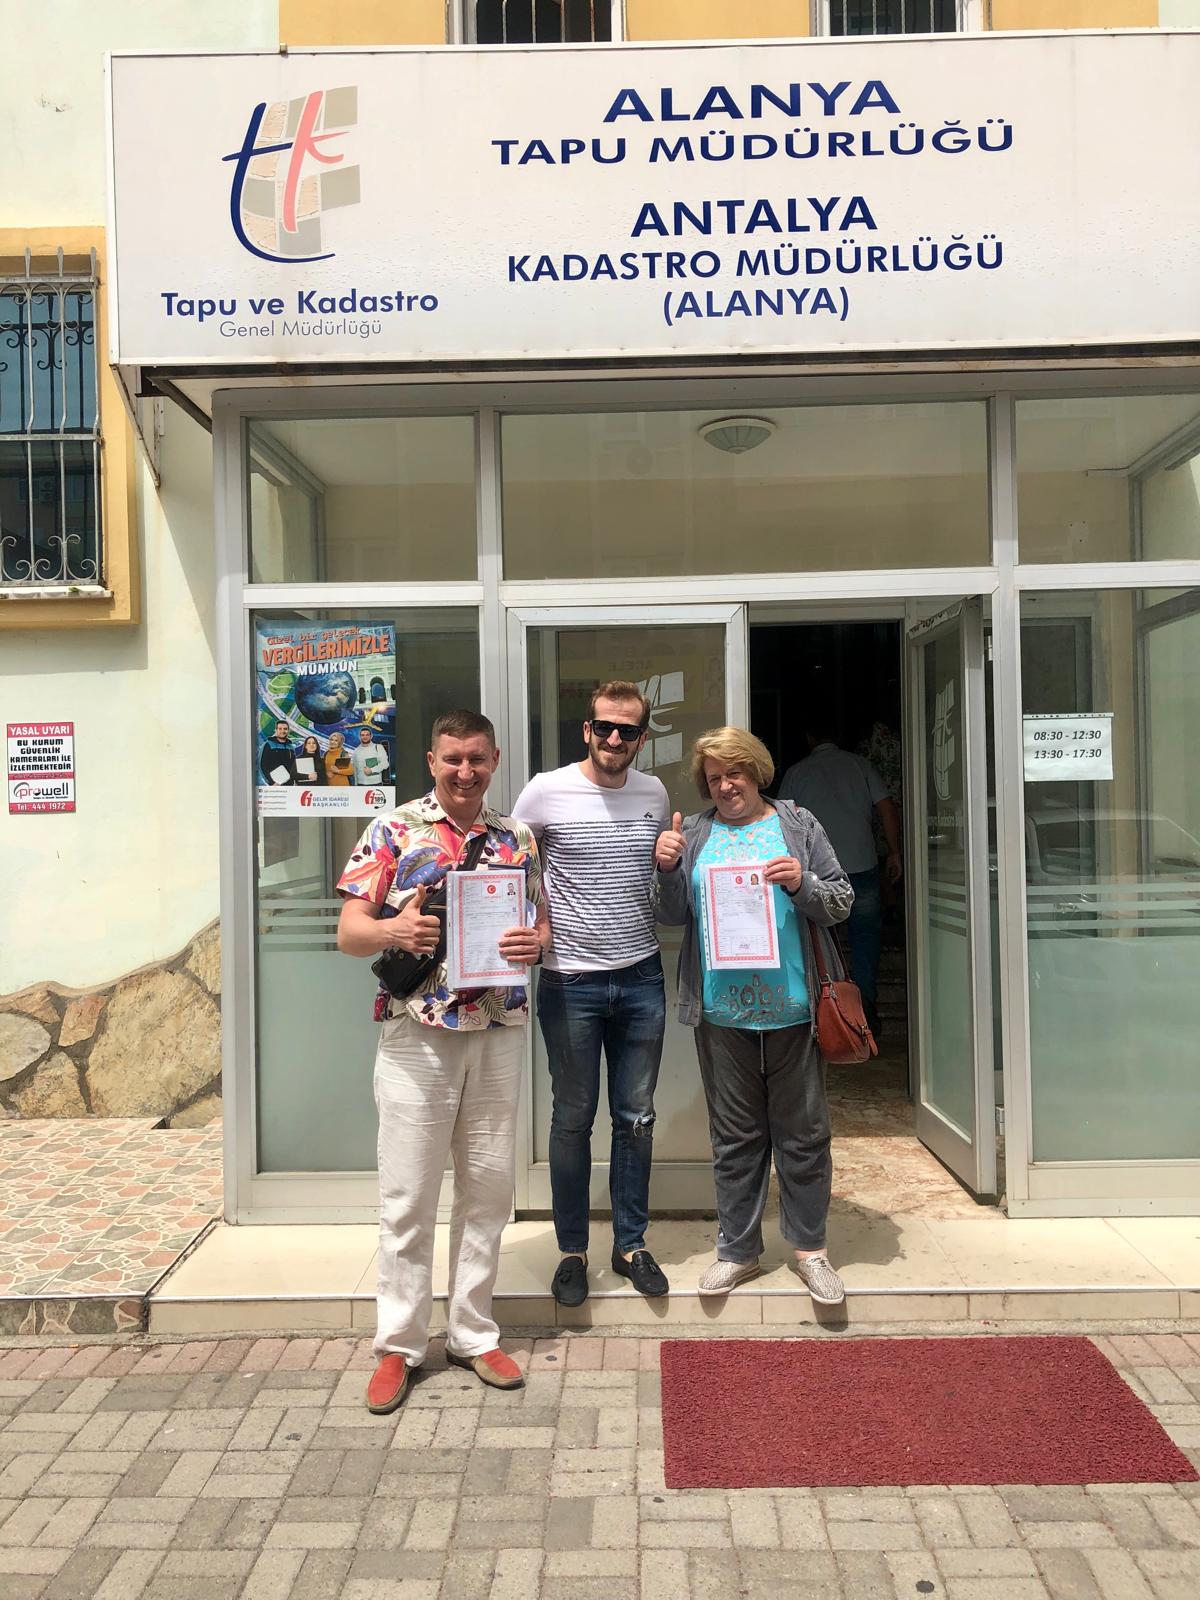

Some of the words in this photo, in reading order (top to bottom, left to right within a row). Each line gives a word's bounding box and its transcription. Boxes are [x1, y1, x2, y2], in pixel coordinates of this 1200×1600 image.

[603, 80, 902, 123] ALANYA
[491, 138, 627, 165] TAPU
[648, 118, 1014, 163] MÜDÜRLÜĞÜ
[630, 196, 878, 238] ANTALYA
[508, 250, 721, 282] KADASTRO
[735, 234, 1004, 277] MÜDÜRLÜĞÜ
[161, 292, 237, 322] Tapu
[248, 298, 285, 315] ve
[298, 288, 439, 314] Kadastro
[663, 286, 849, 326] (ALANYA)
[219, 320, 275, 338] Genel
[282, 318, 382, 339] Müdürlüğü
[262, 634, 391, 667] VERGİLERİMİZLE
[297, 659, 359, 676] MÜMKÜN
[10, 727, 40, 736] YASAL
[42, 725, 70, 735] UYARI
[1033, 731, 1063, 741] 08:30
[1072, 730, 1102, 740] 12:30
[10, 755, 59, 763] KAMERALARI
[61, 754, 71, 762] İLE
[20, 746, 61, 755] GÜVENLİK
[1034, 749, 1063, 759] 13:30
[1073, 748, 1102, 758] 17:30
[10, 763, 72, 771] İZLENMEKTEDİR
[49, 802, 66, 810] 1972
